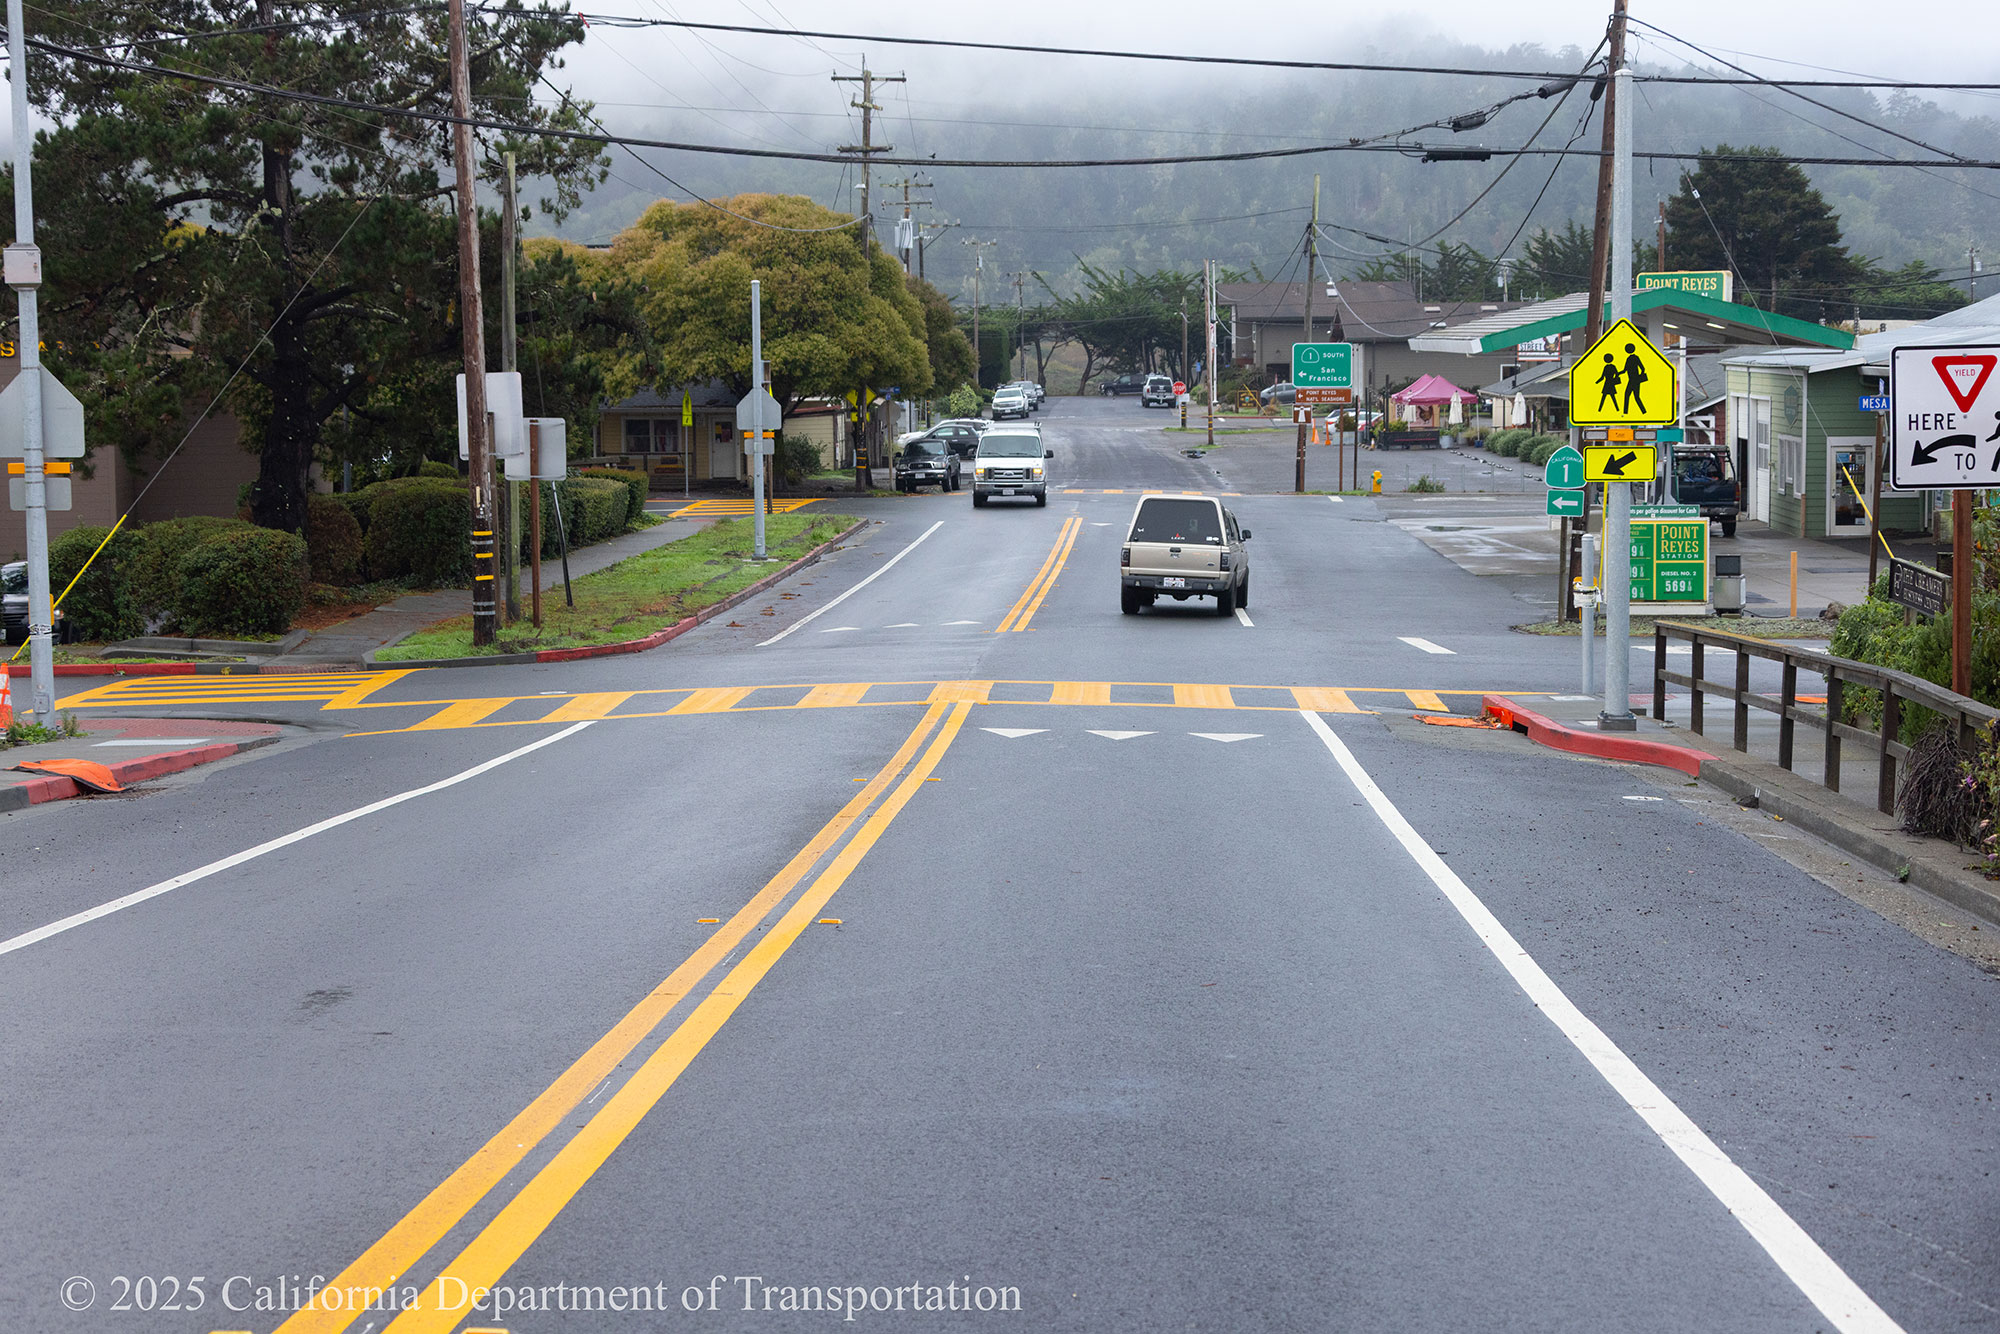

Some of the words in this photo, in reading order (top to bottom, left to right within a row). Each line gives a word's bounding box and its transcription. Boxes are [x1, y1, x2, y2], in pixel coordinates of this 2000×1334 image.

[1646, 278, 1678, 289] POINT
[1682, 277, 1717, 291] REYES
[1862, 398, 1887, 409] MESA
[1909, 413, 1956, 431] HERE
[1954, 453, 1976, 470] TO
[1563, 464, 1568, 483] 1
[1661, 525, 1699, 539] POINT
[1661, 540, 1699, 552] REYES
[1665, 581, 1685, 592] 569
